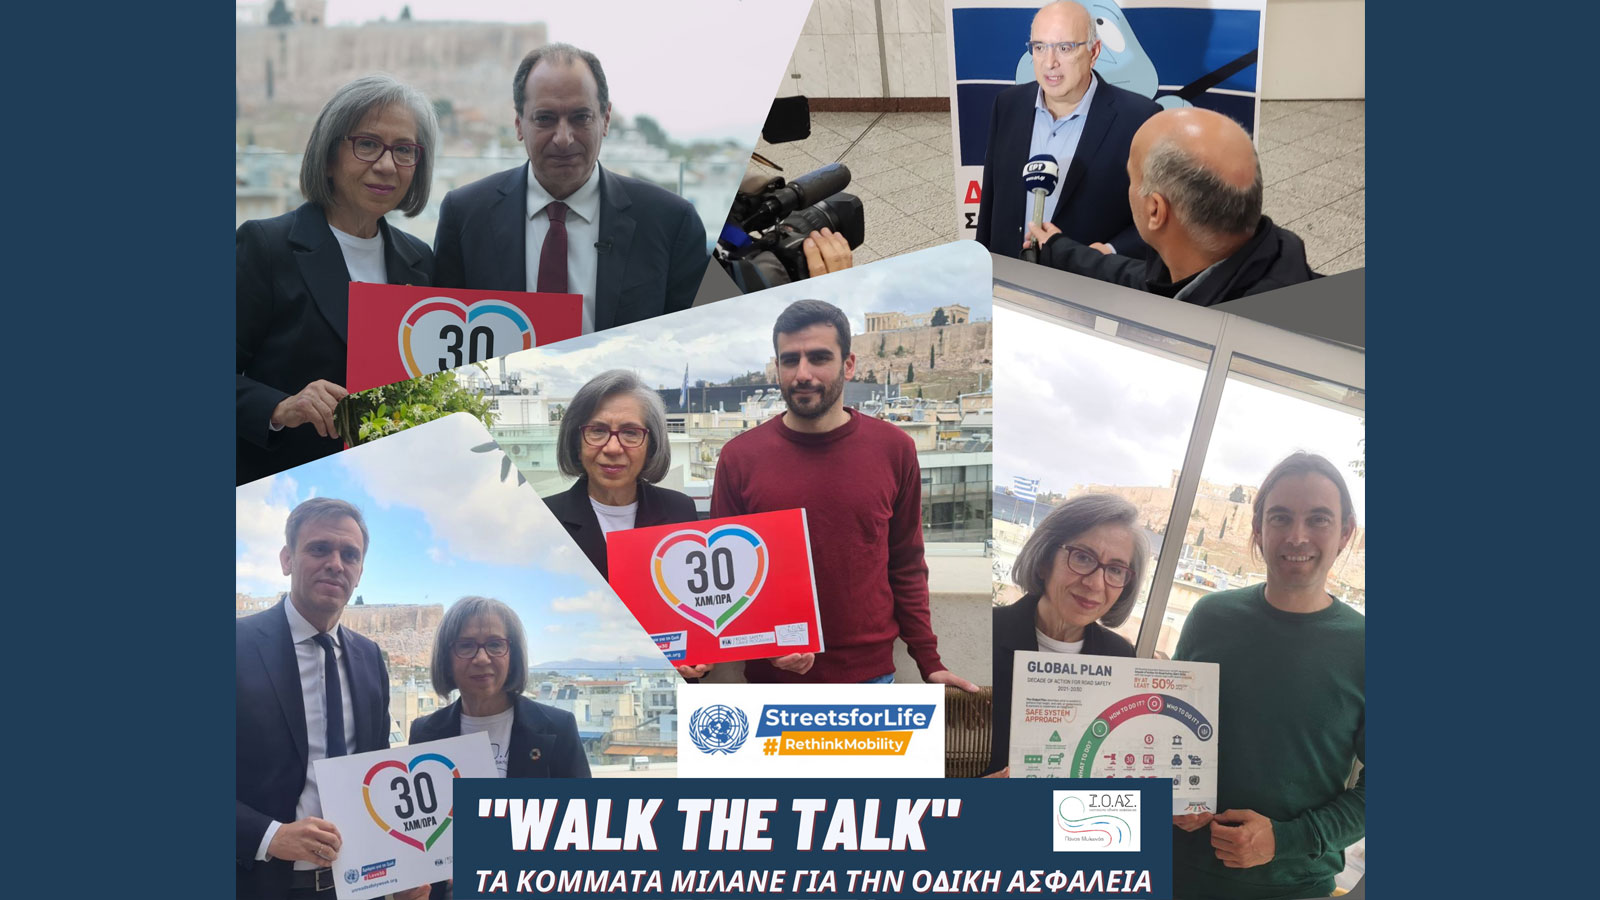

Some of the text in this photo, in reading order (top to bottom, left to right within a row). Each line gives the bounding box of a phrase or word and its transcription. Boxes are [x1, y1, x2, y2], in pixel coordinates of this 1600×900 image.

[438, 324, 494, 371] 30
[685, 547, 735, 594] 30
[694, 593, 732, 607] ΧΛΜ/ΩΡΑ
[1027, 661, 1112, 676] GLOBAL PLAN
[1152, 678, 1175, 690] 50%
[1166, 703, 1178, 711] WHO
[1108, 710, 1121, 720] HOW
[390, 772, 438, 819] 30
[403, 816, 437, 831] ΧΛΜ/ΩΡΑ
